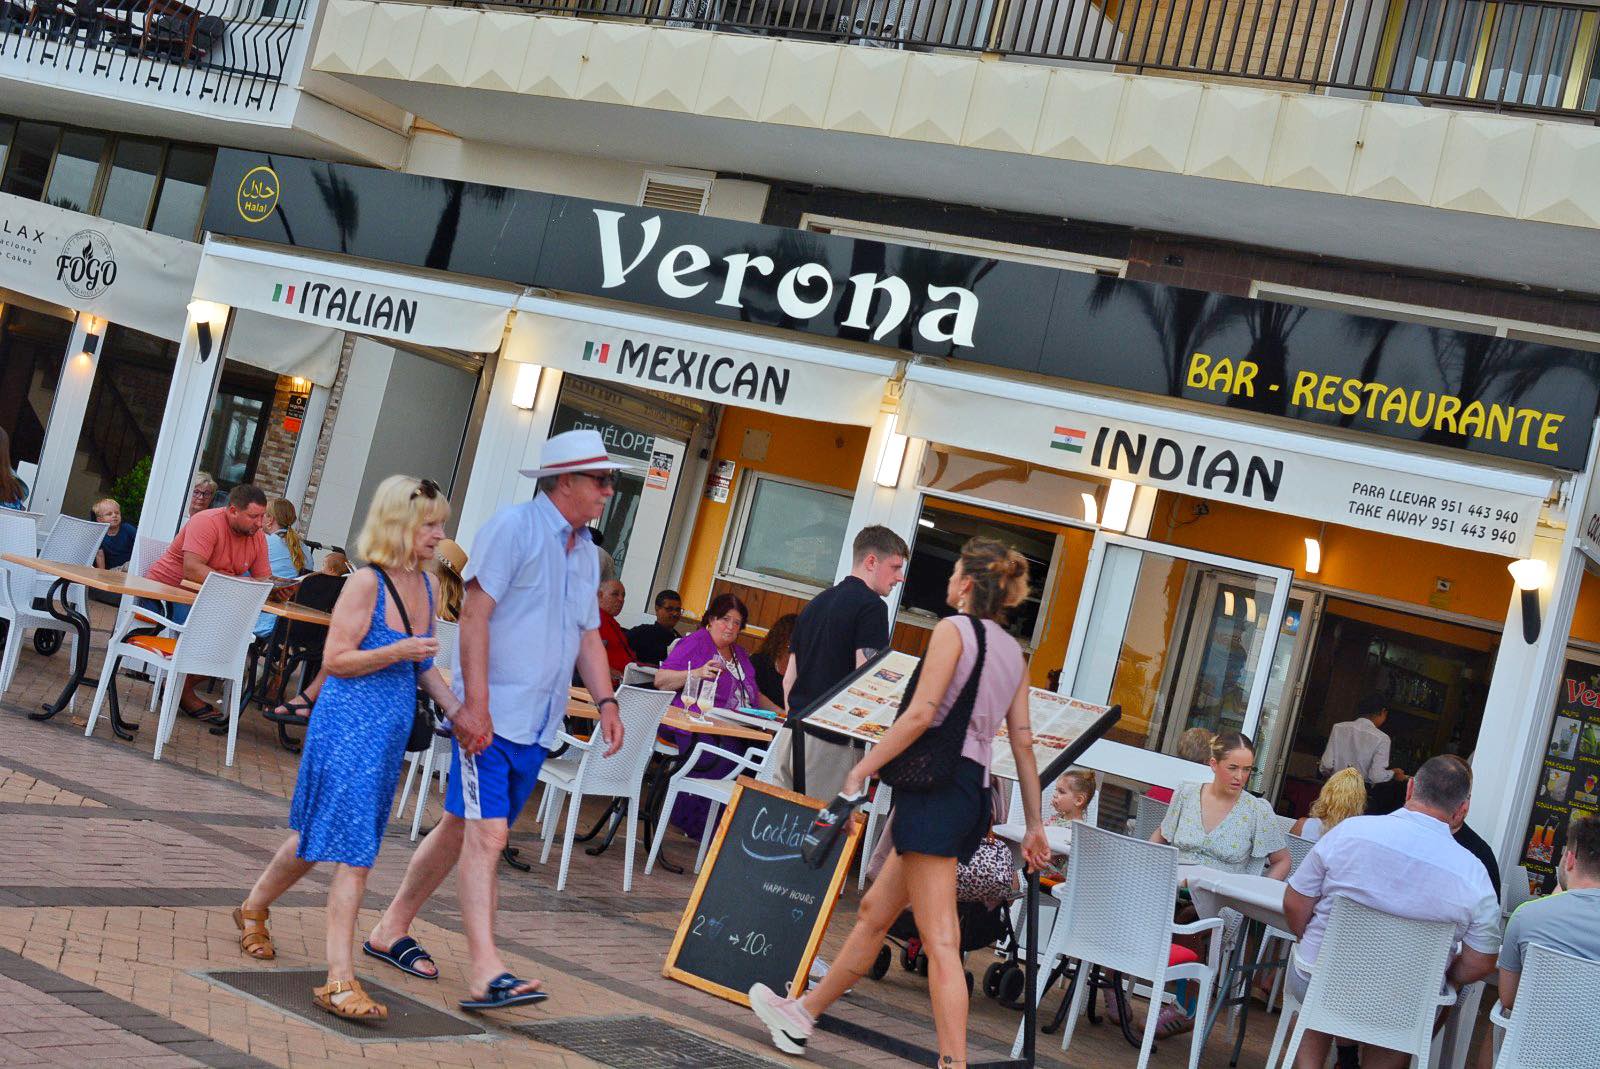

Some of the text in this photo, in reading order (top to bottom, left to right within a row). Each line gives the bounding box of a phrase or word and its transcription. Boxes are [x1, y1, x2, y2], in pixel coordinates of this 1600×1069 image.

[242, 179, 275, 199] حلال
[244, 201, 268, 213] Halal
[6, 251, 33, 266] Cakes
[592, 208, 979, 348] Verona
[298, 281, 418, 334] ITALIAN
[616, 339, 790, 406] MEXICAN
[1187, 352, 1260, 398] BAR
[1291, 369, 1565, 452] RESTAURANTE
[1090, 426, 1284, 503] INDIAN
[1349, 500, 1517, 545] TAKE AWAY 951 443 940
[1352, 482, 1519, 524] PARA LLEVAR 951 443 940
[762, 881, 817, 906] HAPPY HOURS
[692, 915, 706, 937] 2
